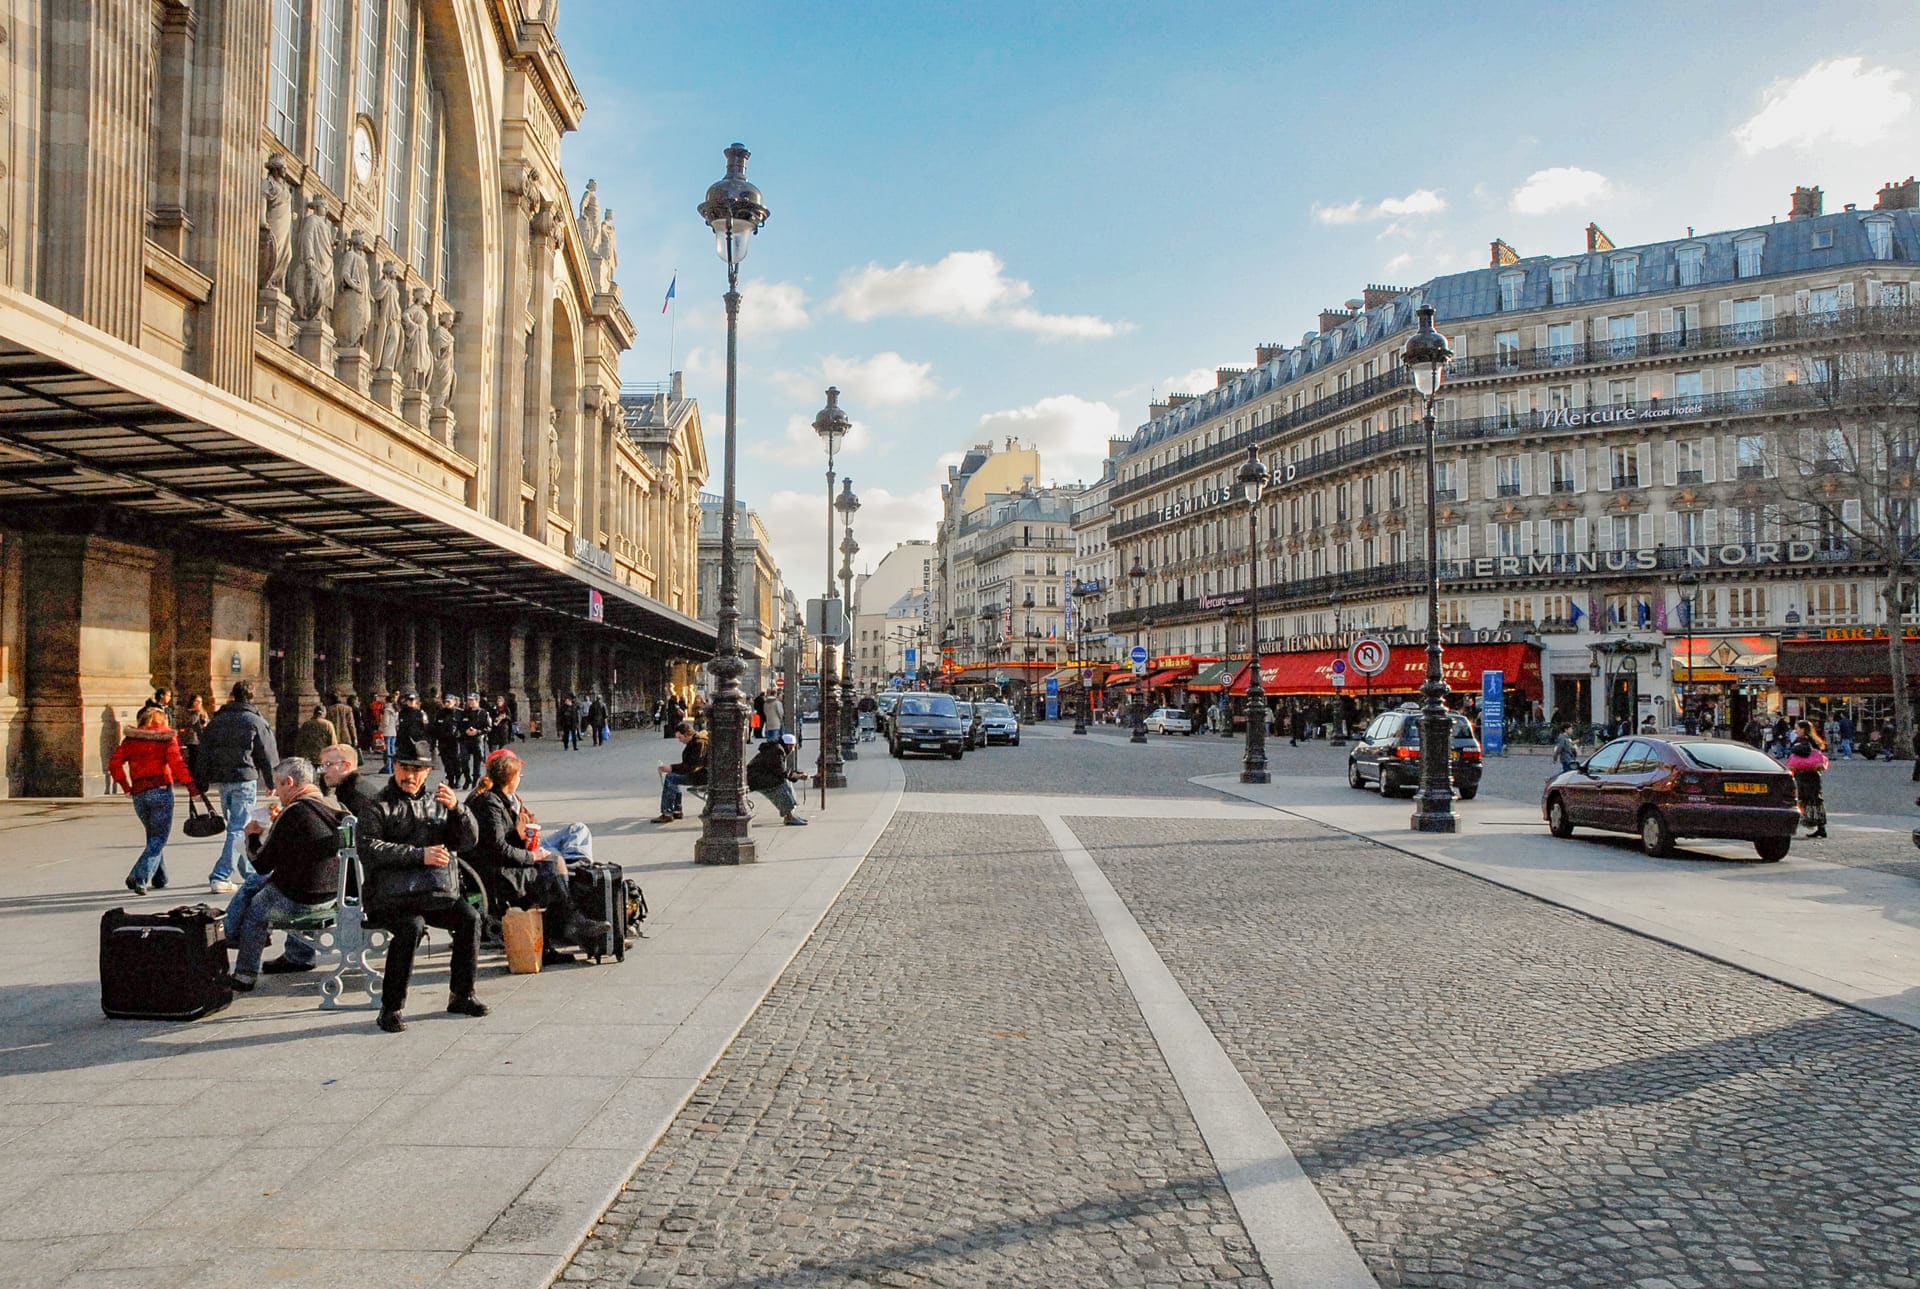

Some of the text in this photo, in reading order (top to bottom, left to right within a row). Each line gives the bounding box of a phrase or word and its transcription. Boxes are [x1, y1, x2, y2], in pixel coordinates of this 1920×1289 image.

[1542, 406, 1636, 428] Mercure
[1158, 486, 1230, 522] TERMINUS
[1452, 541, 1814, 577] TERMINUS NORD
[1199, 593, 1227, 609] Mercure
[1287, 633, 1333, 652] TERMINUS
[1376, 630, 1461, 645] ESTAURNT
[1405, 662, 1464, 671] TERNUS
